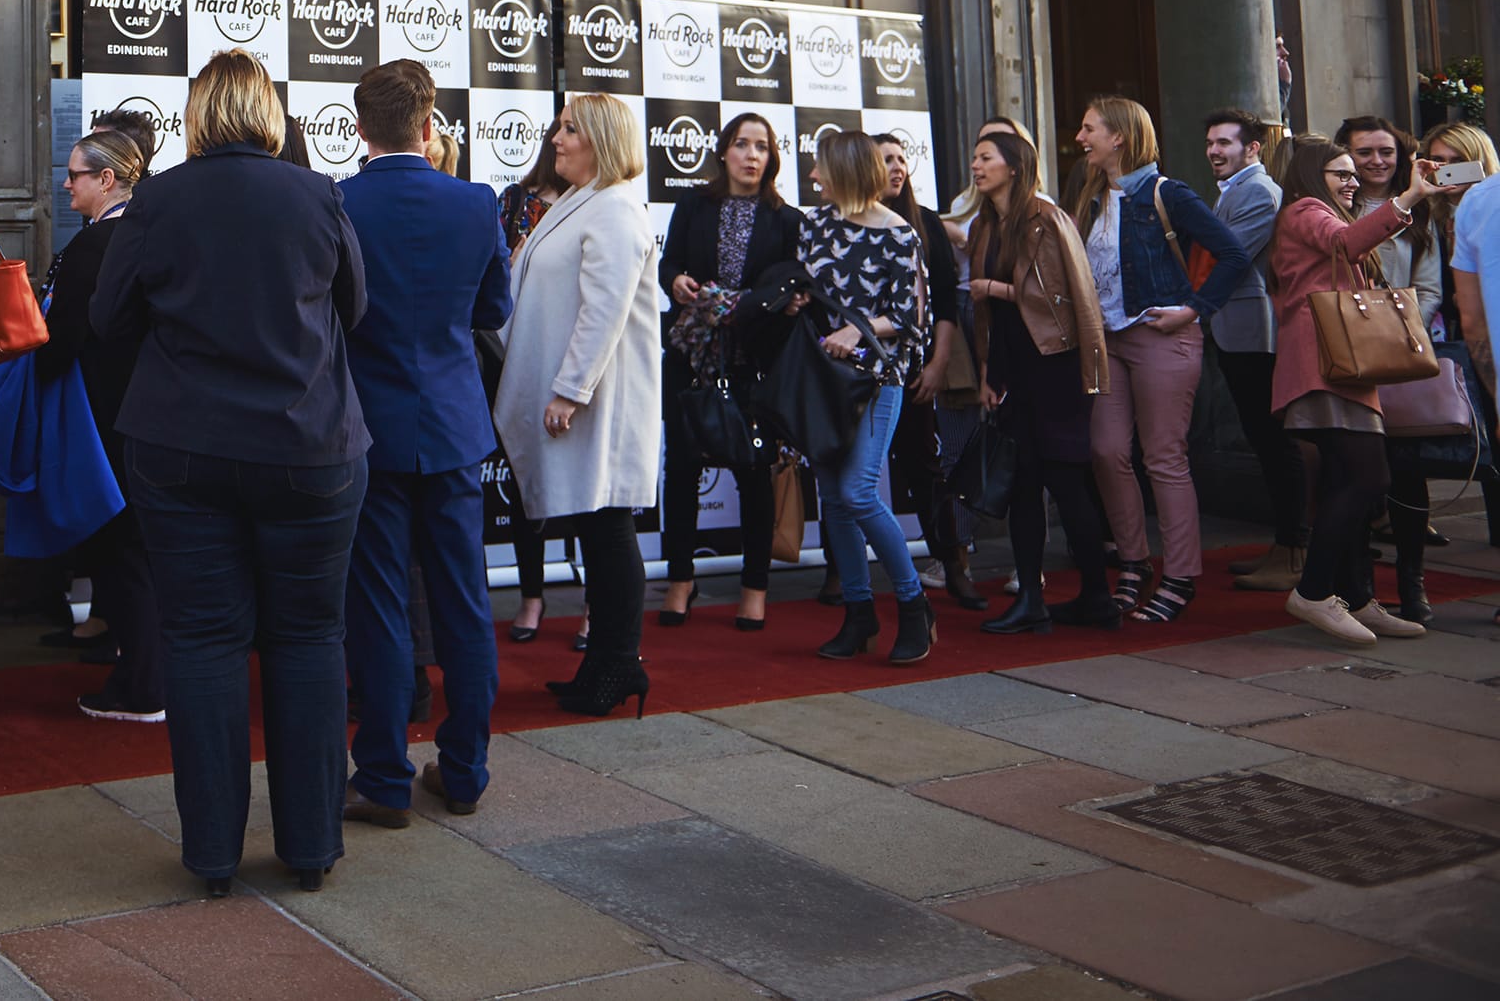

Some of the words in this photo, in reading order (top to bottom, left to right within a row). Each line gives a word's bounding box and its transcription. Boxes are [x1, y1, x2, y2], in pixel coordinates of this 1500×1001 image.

[334, 0, 375, 27] Rock
[386, 4, 425, 26] Hard
[426, 7, 463, 31] Rock
[125, 16, 150, 27] CAFE
[229, 22, 251, 31] CAFE
[473, 9, 512, 31] Hard
[512, 11, 548, 37] Rock
[324, 27, 346, 38] CAFE
[568, 15, 604, 36] Hard
[605, 18, 638, 43] Rock
[416, 32, 435, 42] CAFE
[648, 23, 681, 42] Hard
[682, 26, 714, 47] Rock
[722, 27, 757, 49] Hard
[756, 30, 788, 54] Rock
[501, 37, 522, 47] CAFE
[596, 42, 615, 52] CAFE
[107, 44, 168, 57] EDINBURGH
[309, 54, 363, 66] EDINBURGH
[487, 62, 537, 73] EDINBURGH
[582, 67, 630, 78] EDINBURGH
[336, 117, 358, 140] Ro
[476, 121, 512, 141] Hard
[650, 127, 687, 147] Hard
[686, 129, 718, 152] Rock
[326, 144, 347, 153] CAFE
[504, 148, 524, 157] CAFE
[678, 153, 695, 163] CAFE
[490, 174, 525, 183] EDINBU
